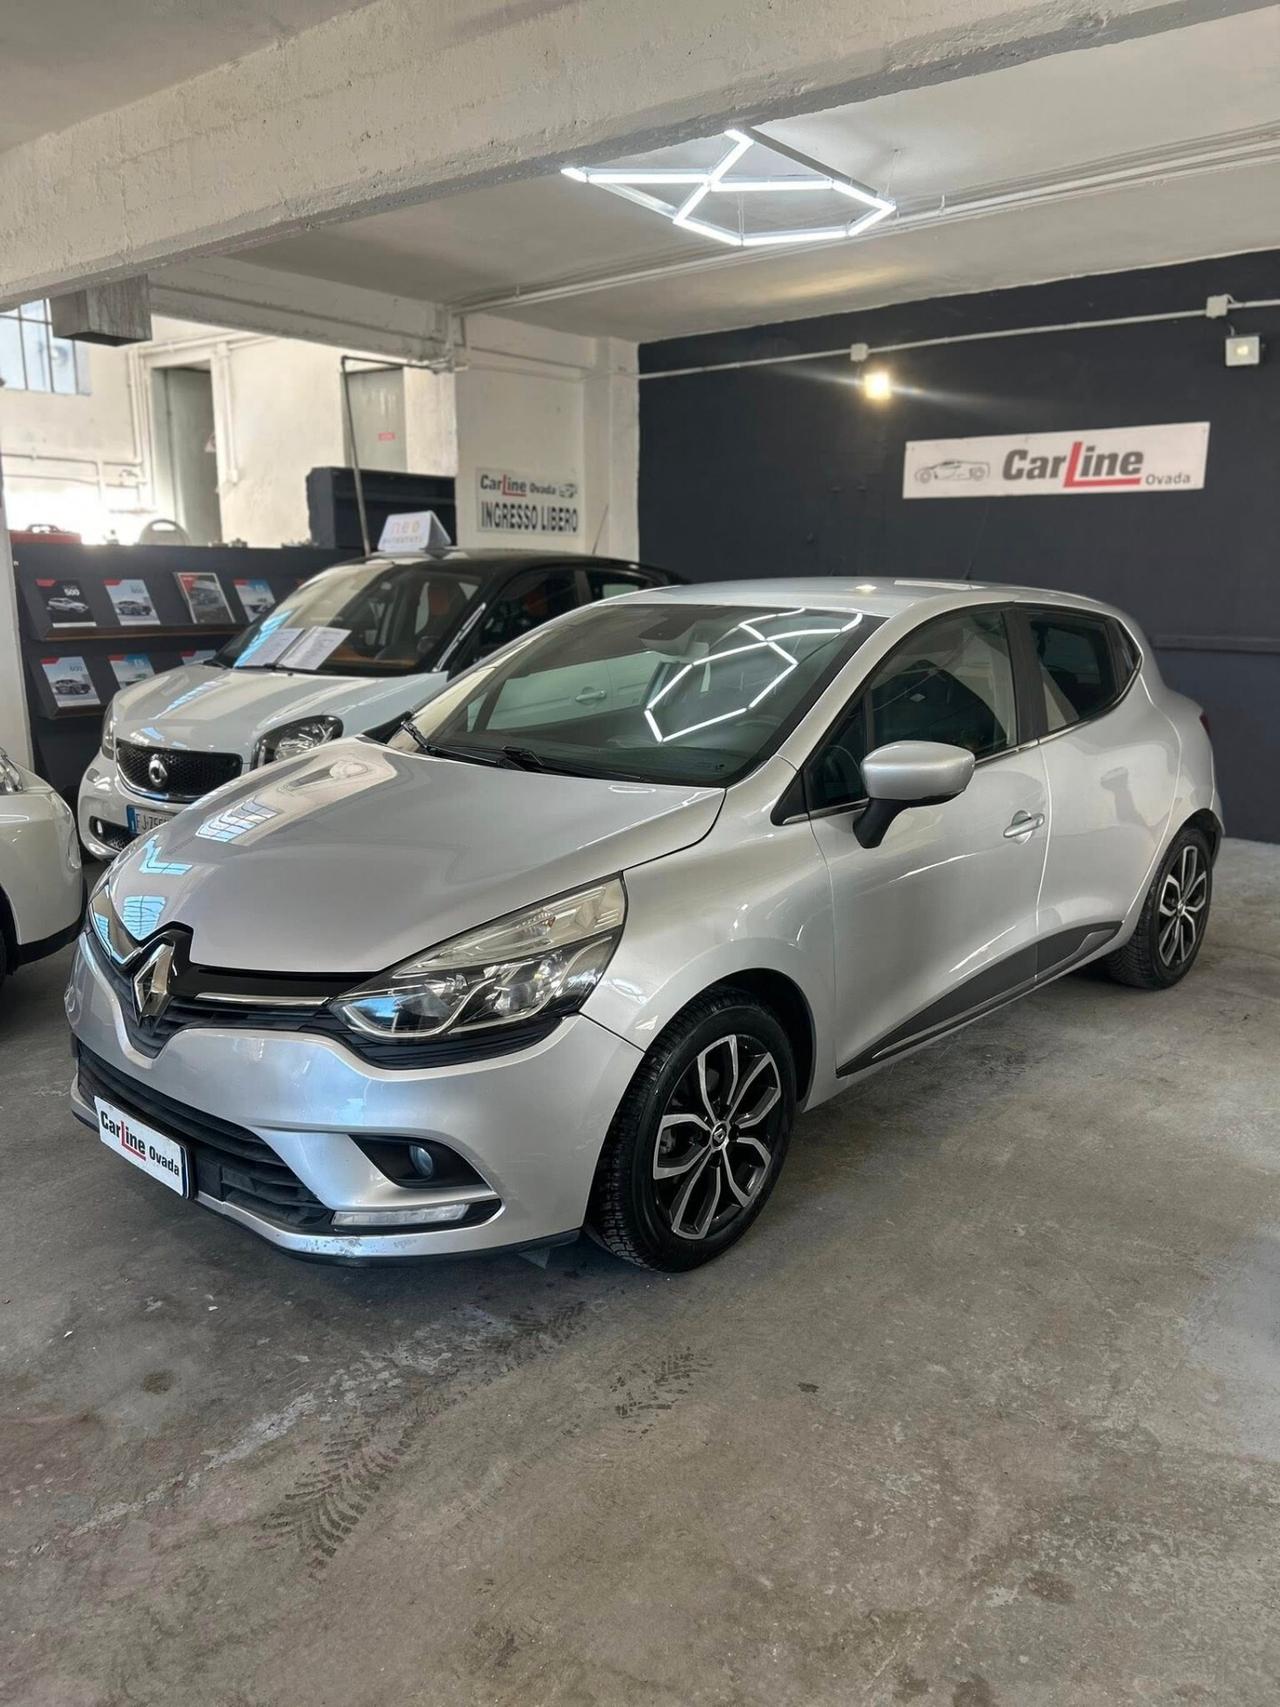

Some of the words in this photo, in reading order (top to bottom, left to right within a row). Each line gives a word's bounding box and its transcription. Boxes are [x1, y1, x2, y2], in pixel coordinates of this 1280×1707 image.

[1002, 441, 1144, 488] CarLine
[1145, 472, 1191, 486] Ovada
[480, 474, 527, 497] CarLine
[529, 483, 556, 495] Ovada
[481, 501, 538, 530] INGRESSO
[541, 505, 577, 532] LIBERO
[100, 1110, 146, 1161] CarLine
[149, 1145, 179, 1177] Ovada
